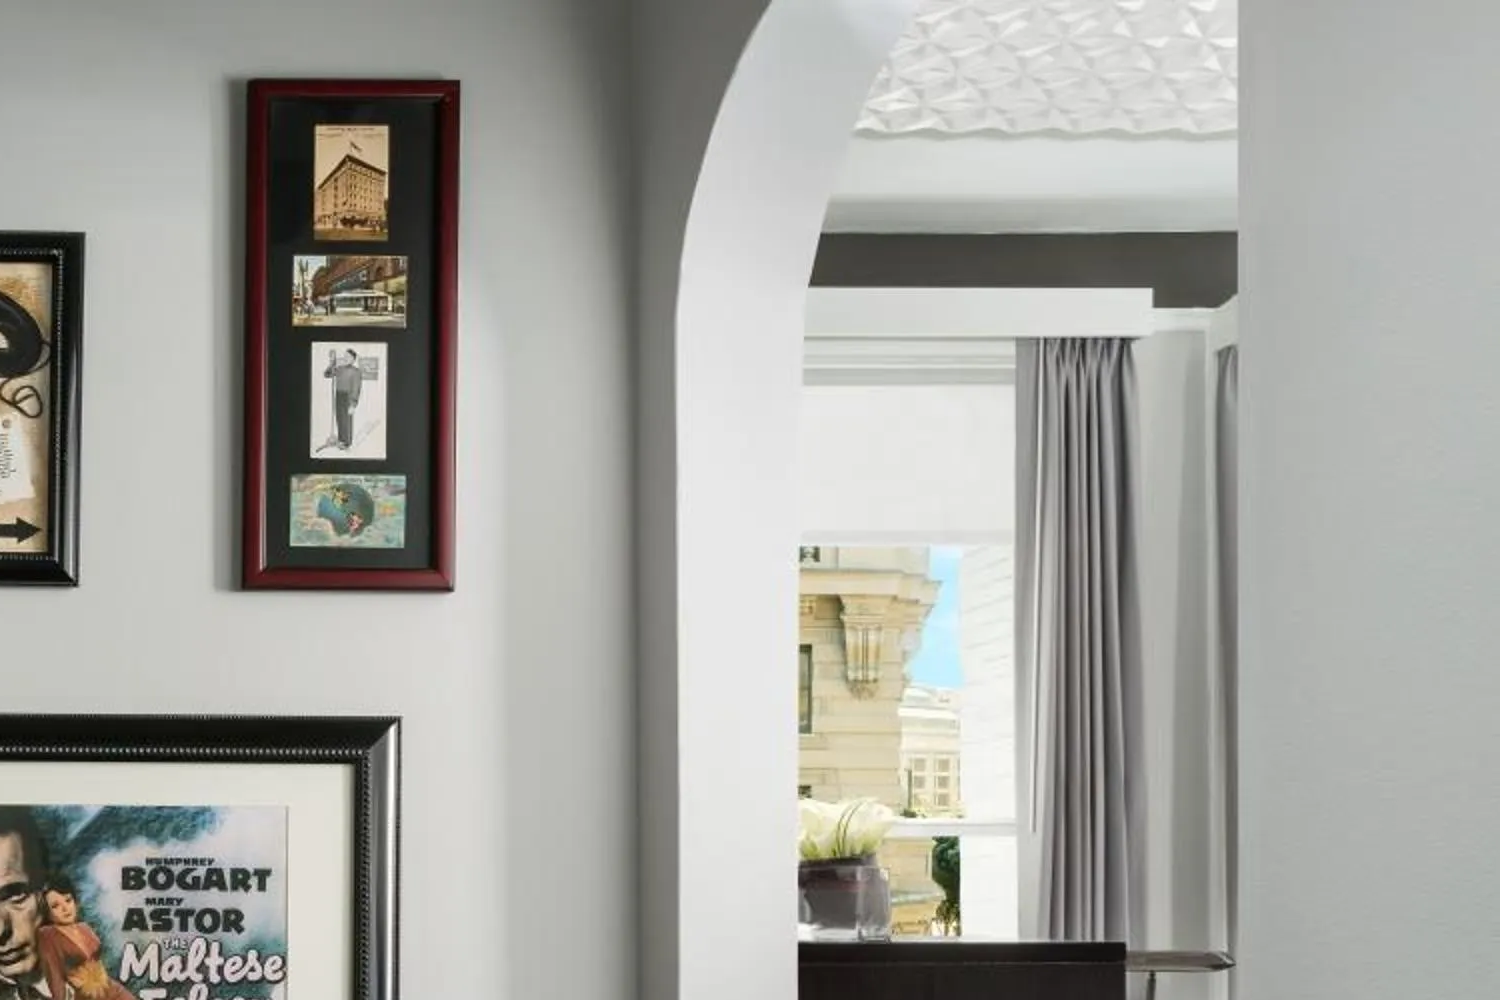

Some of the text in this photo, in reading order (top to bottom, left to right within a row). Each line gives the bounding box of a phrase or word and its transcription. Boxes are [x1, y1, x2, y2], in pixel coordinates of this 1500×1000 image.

[145, 856, 215, 866] HUMPHREY
[121, 865, 273, 893] BOGART
[145, 897, 184, 906] MARY
[121, 907, 245, 935] ASTOR
[163, 938, 189, 950] THE
[118, 936, 287, 985] Maltese
